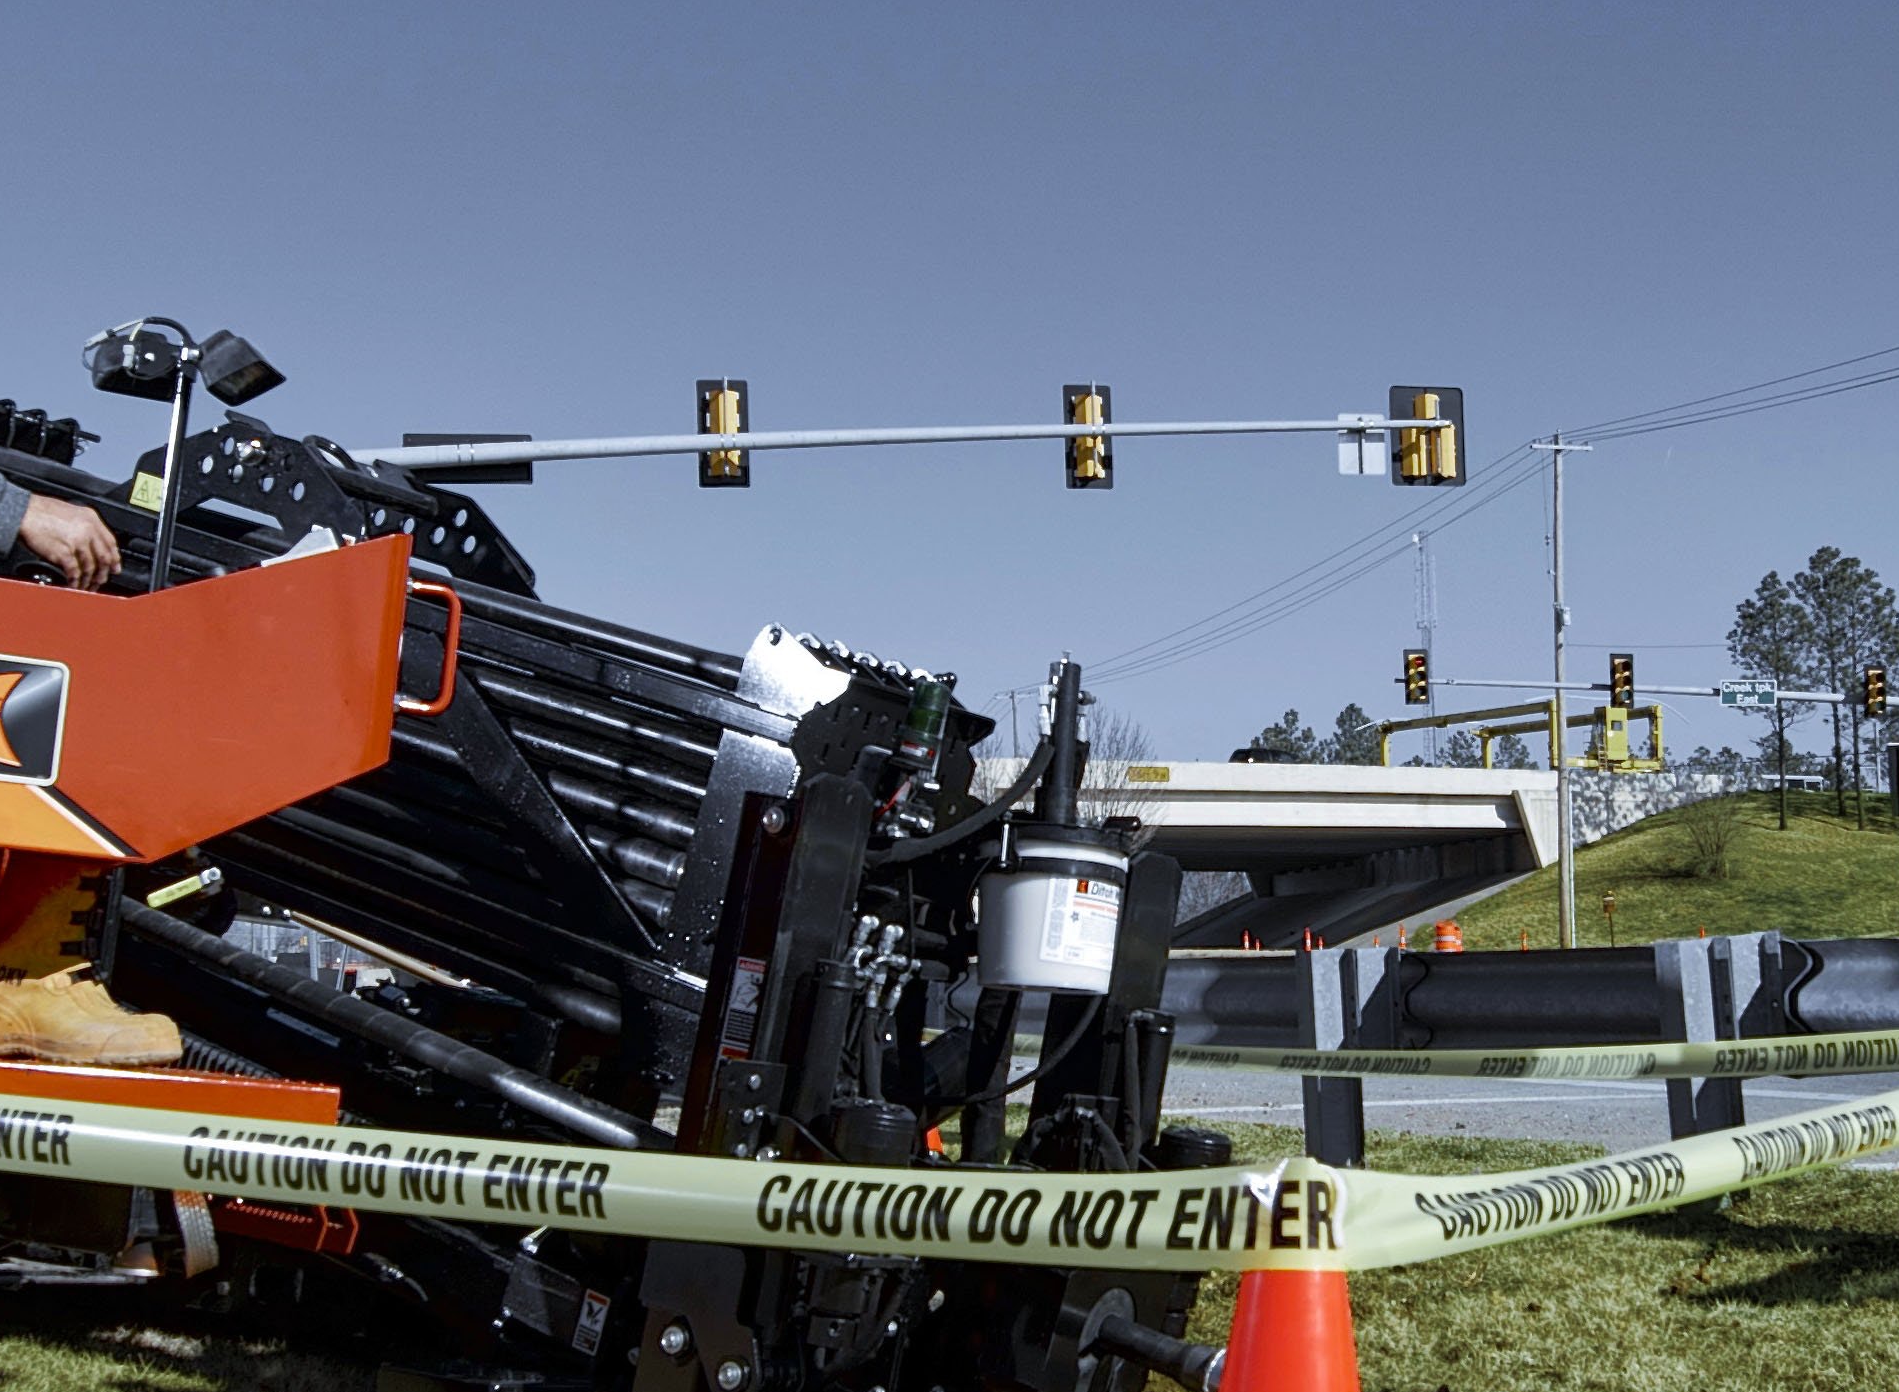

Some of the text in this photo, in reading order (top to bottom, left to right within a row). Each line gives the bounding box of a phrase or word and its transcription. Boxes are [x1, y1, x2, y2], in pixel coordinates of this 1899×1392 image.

[1723, 682, 1752, 693] Creek
[1736, 694, 1758, 704] East
[183, 1126, 611, 1220] CAUTION DO NOT ENTER
[1414, 1152, 1687, 1241] CAUTION DO NOT ENTER
[756, 1174, 1338, 1251] CAUTION DO NOT ENTER
